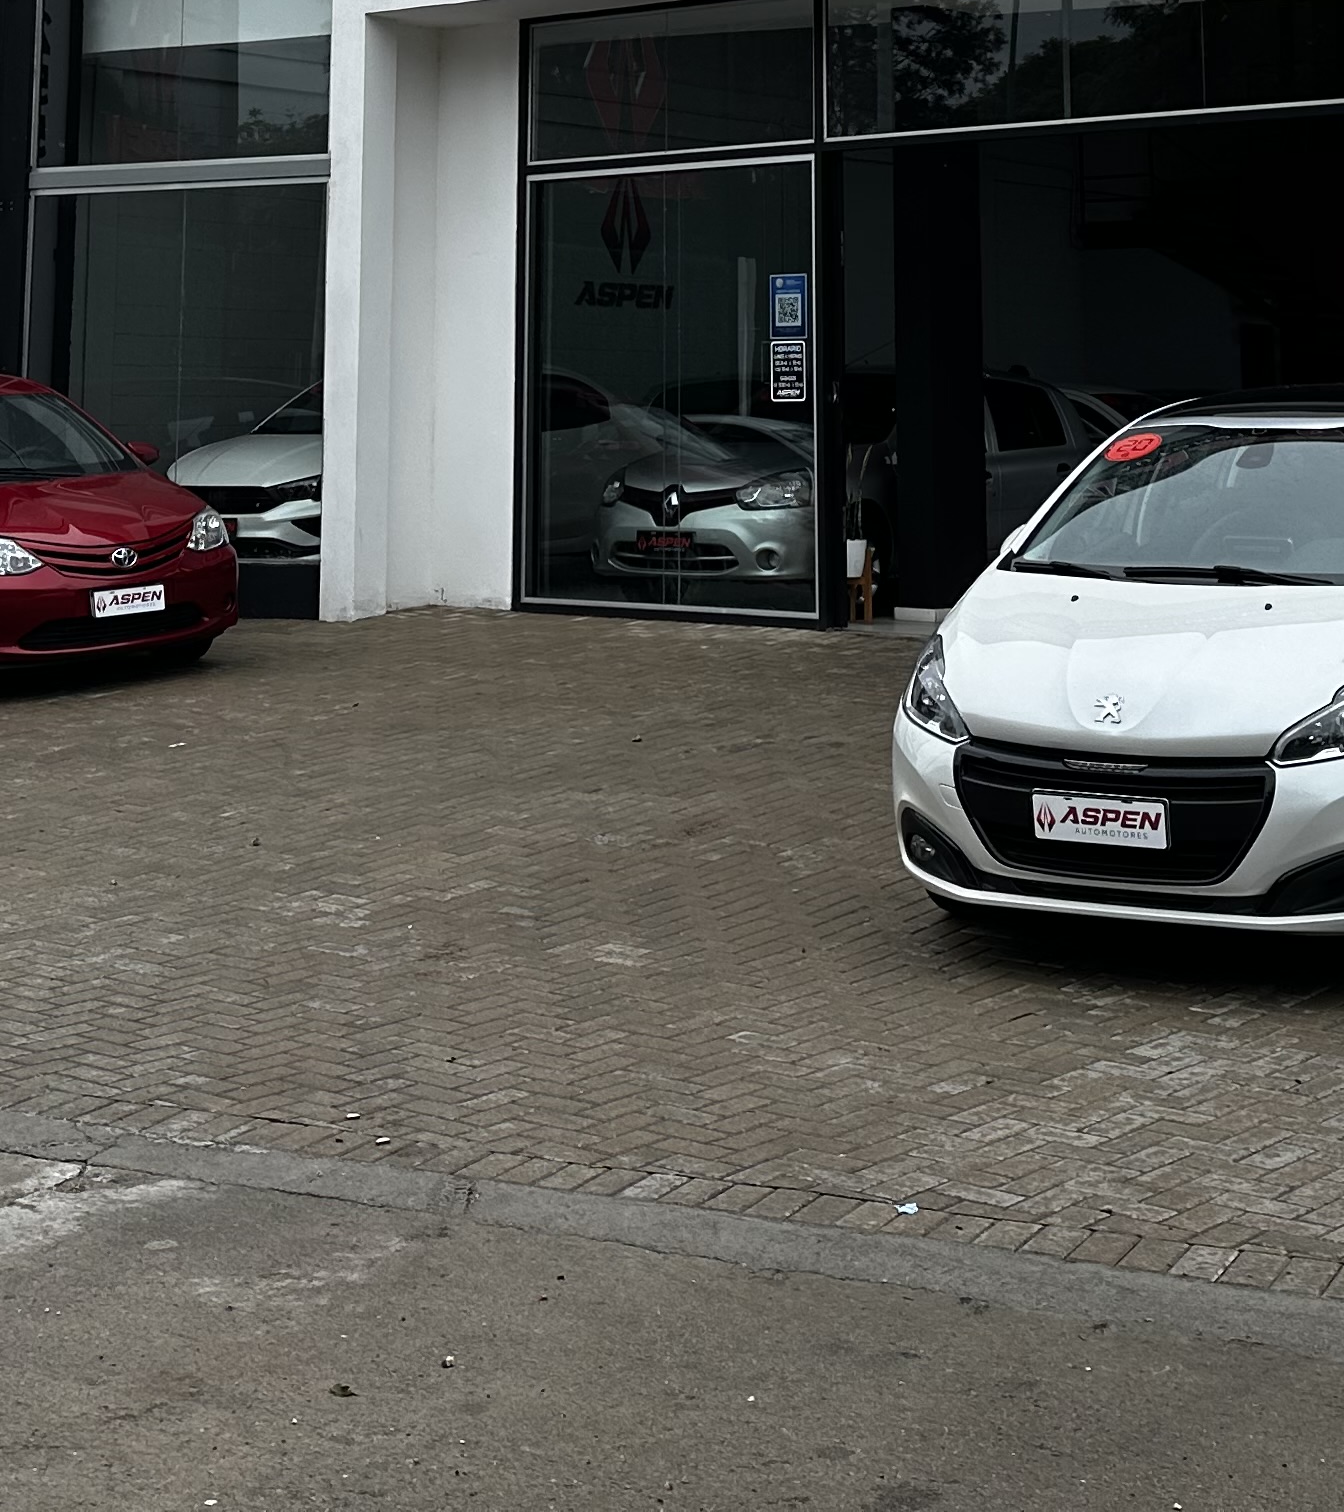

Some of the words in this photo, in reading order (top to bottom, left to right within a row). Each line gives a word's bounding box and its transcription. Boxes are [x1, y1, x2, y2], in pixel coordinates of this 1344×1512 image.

[574, 281, 675, 309] ASPEN
[109, 589, 163, 606] ASPEN
[1059, 805, 1163, 831] ASPEN
[1074, 827, 1149, 840] AUTOMOTORES
